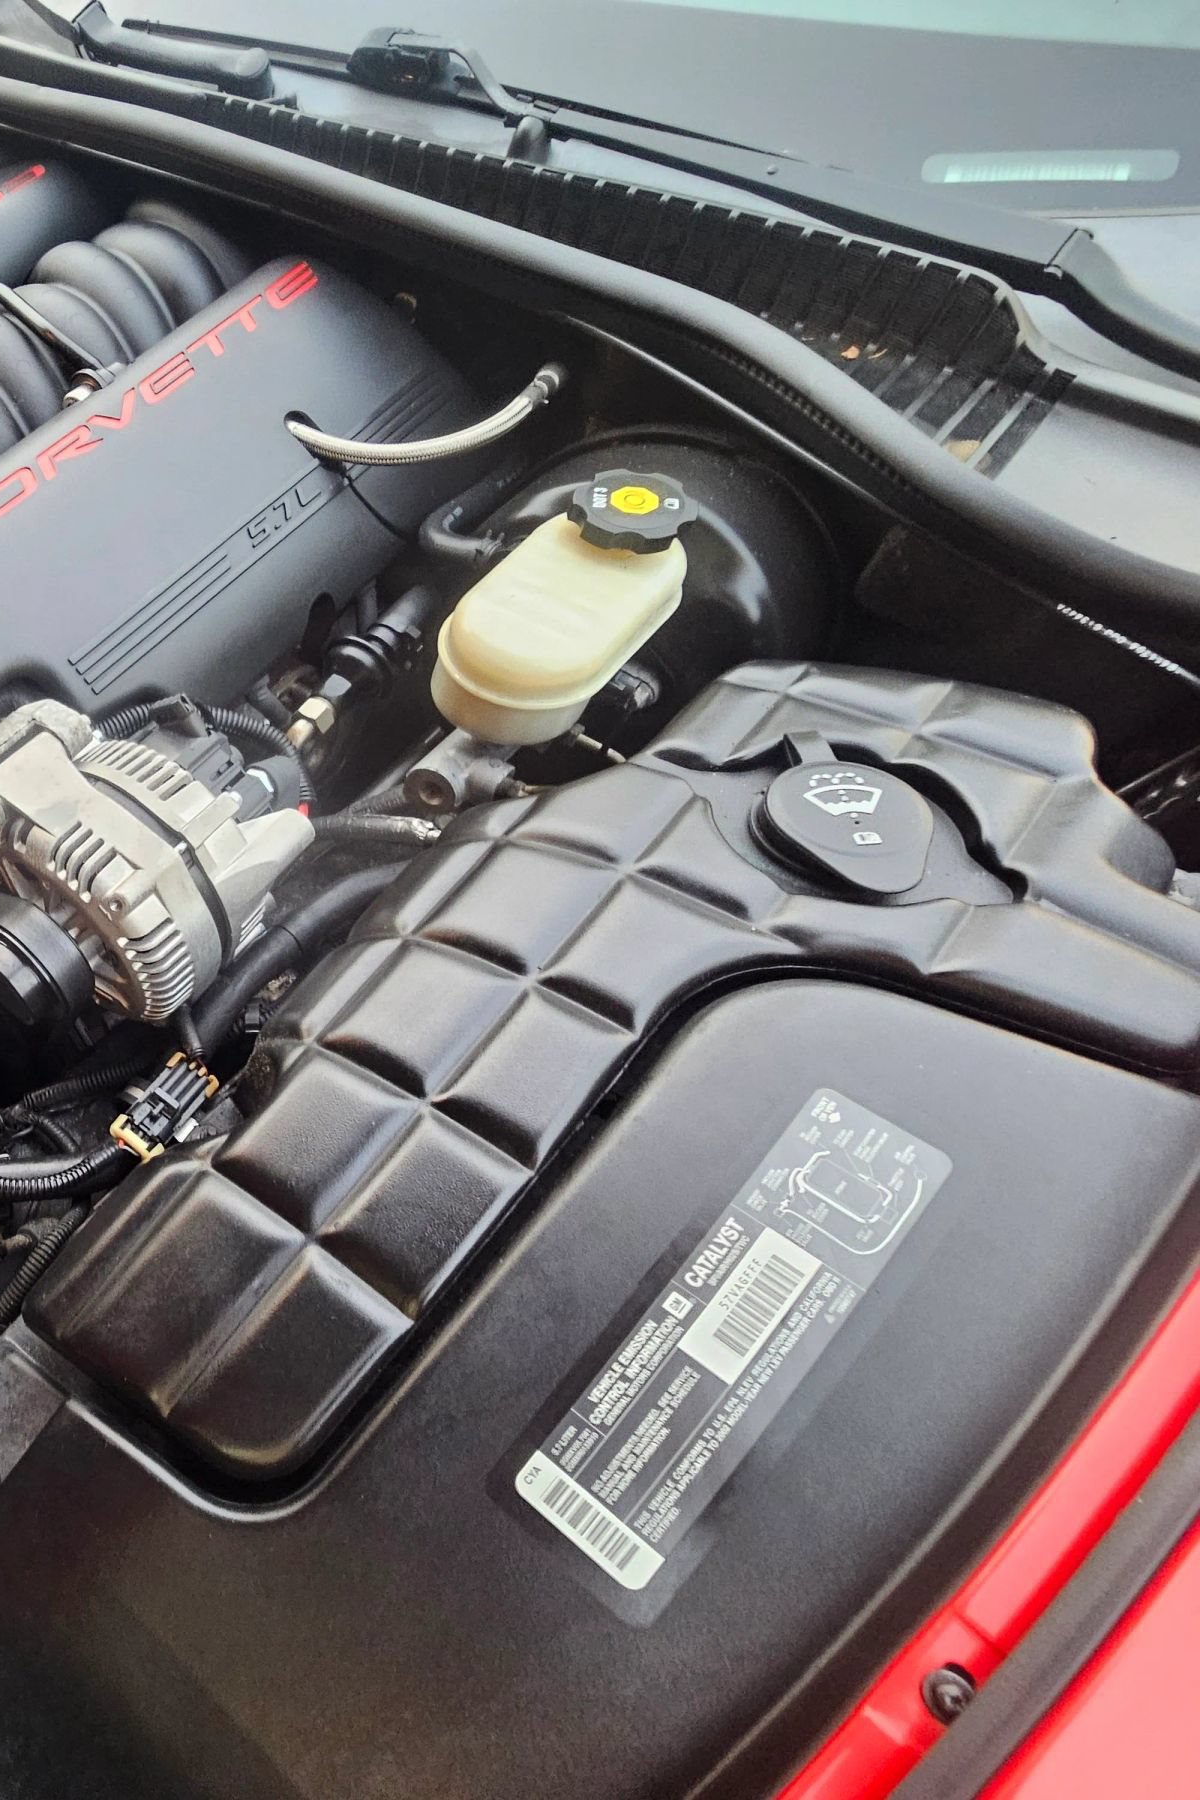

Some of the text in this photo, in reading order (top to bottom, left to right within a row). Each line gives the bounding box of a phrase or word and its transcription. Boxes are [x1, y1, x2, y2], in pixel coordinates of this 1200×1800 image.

[246, 487, 323, 549] 5.7L
[592, 493, 607, 507] DOT
[682, 1215, 746, 1290] CATALYST
[587, 1318, 658, 1404] VEHICLE EMISSION
[588, 1314, 679, 1426] CONTROL INFORMATION
[602, 1324, 685, 1426] GENERAL MOTORS CORPORATION
[633, 1270, 834, 1530] THIS VEHICLE CONFORMS TO U.S. EPA NLEV REGULATIONS AND CALIFORNIA
[558, 1424, 577, 1446] LITER
[590, 1364, 693, 1493] NO ADJUSTMENTS NEEDED. SEE SERVICE
[597, 1370, 701, 1500] MANUAL AND MAINTENANCE SCHEDULE
[640, 1488, 681, 1537] REGULATIONS
[675, 1448, 712, 1492] APPLICABLE
[706, 1438, 719, 1452] TO
[725, 1381, 763, 1426] MODEL-YEAR
[757, 1366, 774, 1385] NEW
[768, 1353, 784, 1370] LEV
[778, 1316, 812, 1357] PASSENGER
[822, 1281, 838, 1298] OBD
[523, 1464, 542, 1485] CYA
[605, 1424, 671, 1506] FOR MORE INFORMATION.
[648, 1504, 681, 1543] CERTIFIED.
